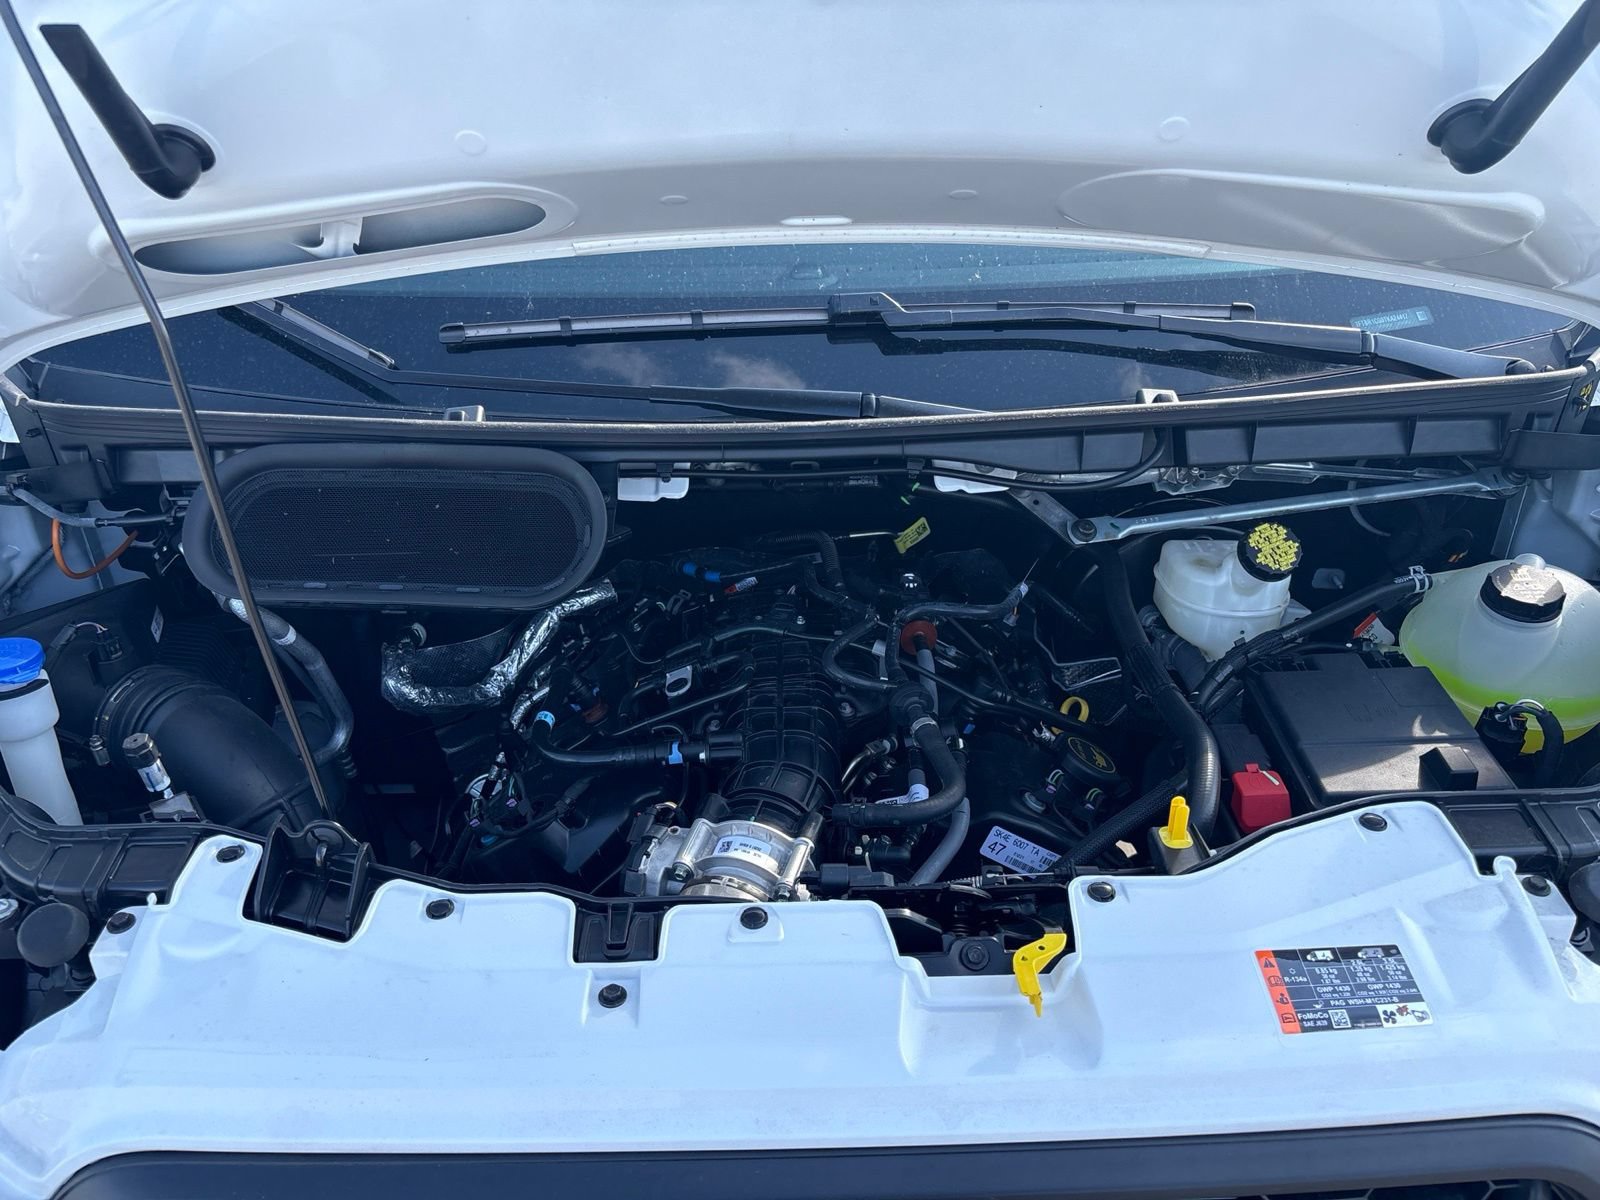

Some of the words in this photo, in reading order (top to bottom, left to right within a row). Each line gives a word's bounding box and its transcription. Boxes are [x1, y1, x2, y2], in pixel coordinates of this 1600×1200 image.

[988, 842, 1007, 856] 47
[1012, 838, 1029, 850] 6007
[1030, 846, 1040, 856] TA
[1298, 1012, 1328, 1020] FoMoCo
